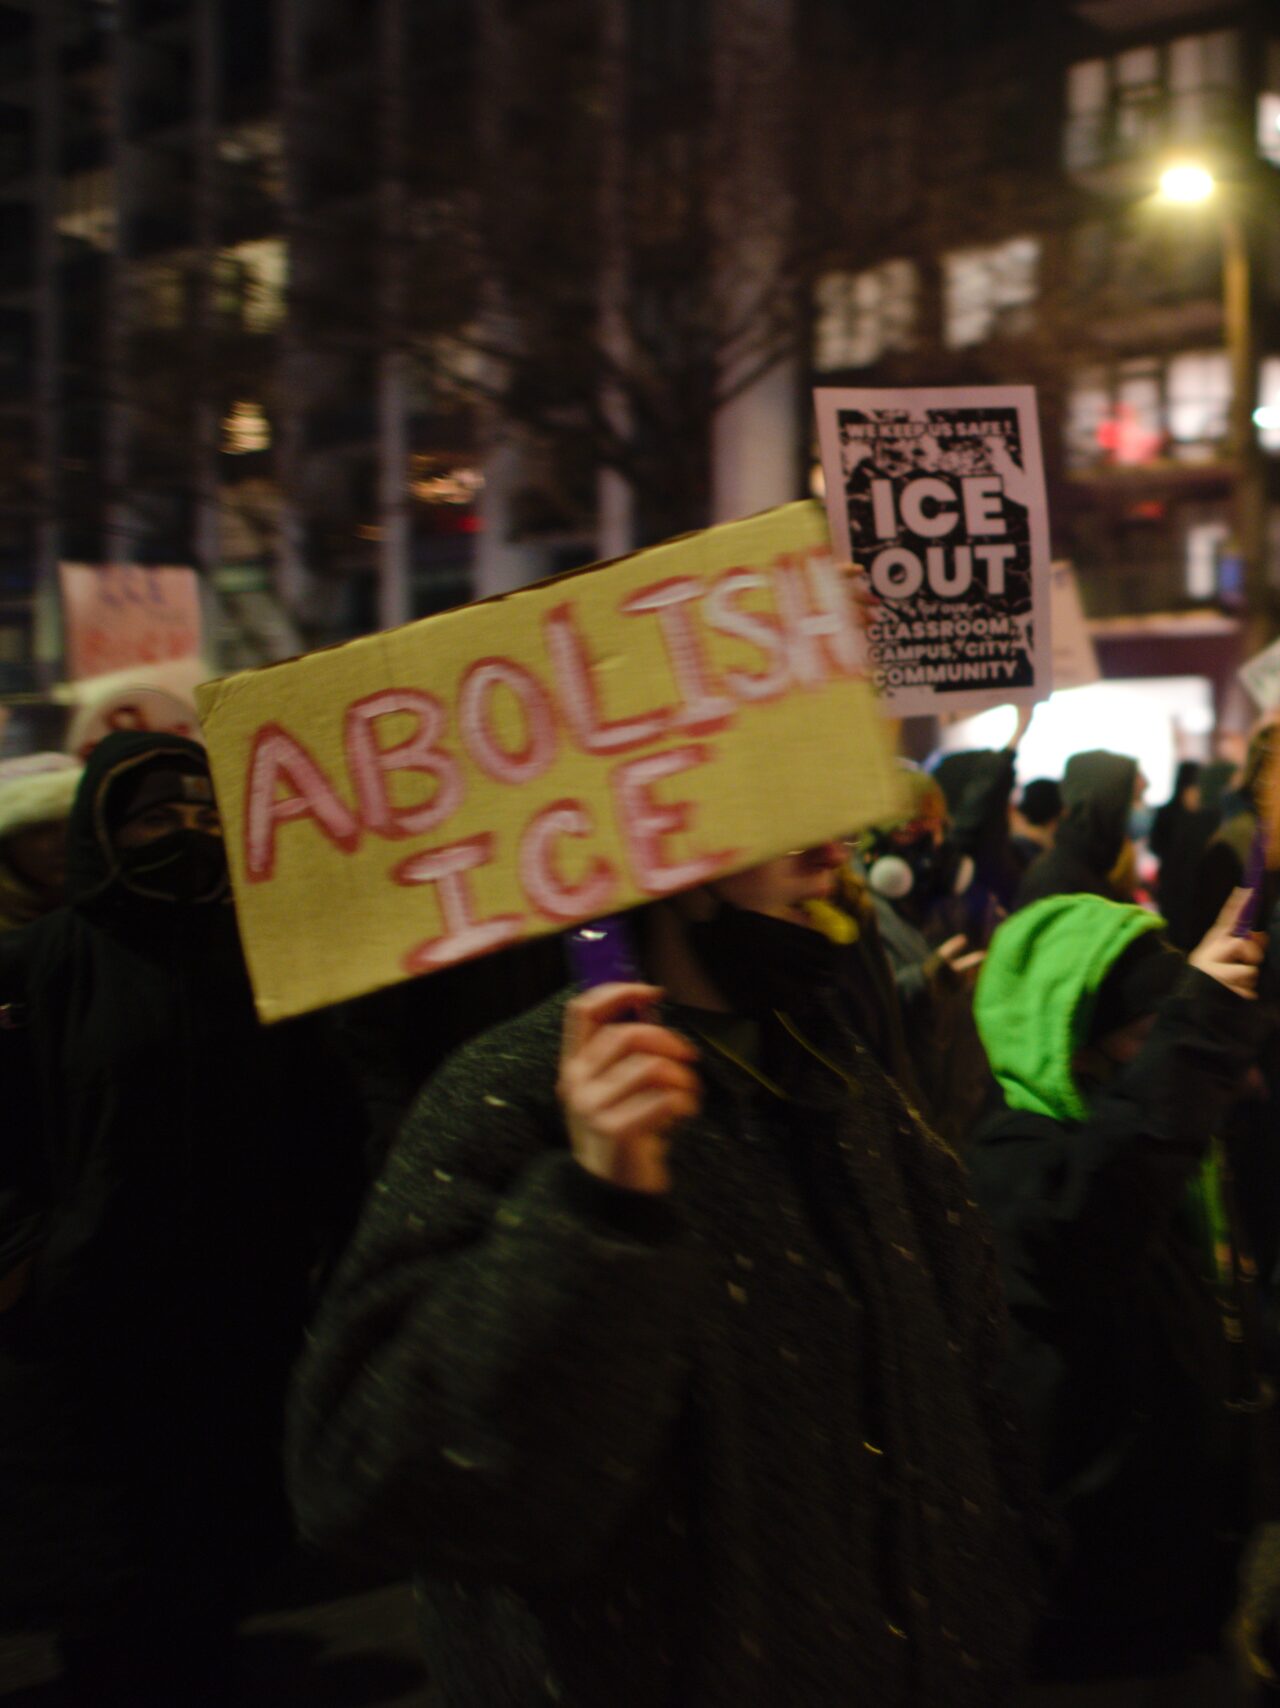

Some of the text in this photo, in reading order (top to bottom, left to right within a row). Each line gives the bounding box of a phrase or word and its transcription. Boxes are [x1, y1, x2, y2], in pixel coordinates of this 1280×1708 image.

[879, 421, 926, 437] KEEP
[928, 420, 954, 437] US
[870, 475, 1007, 539] ICE
[870, 545, 1016, 599] OUT
[873, 660, 1018, 687] COMMUNITY
[244, 546, 870, 883] ABOLISH
[388, 744, 750, 976] ICE
